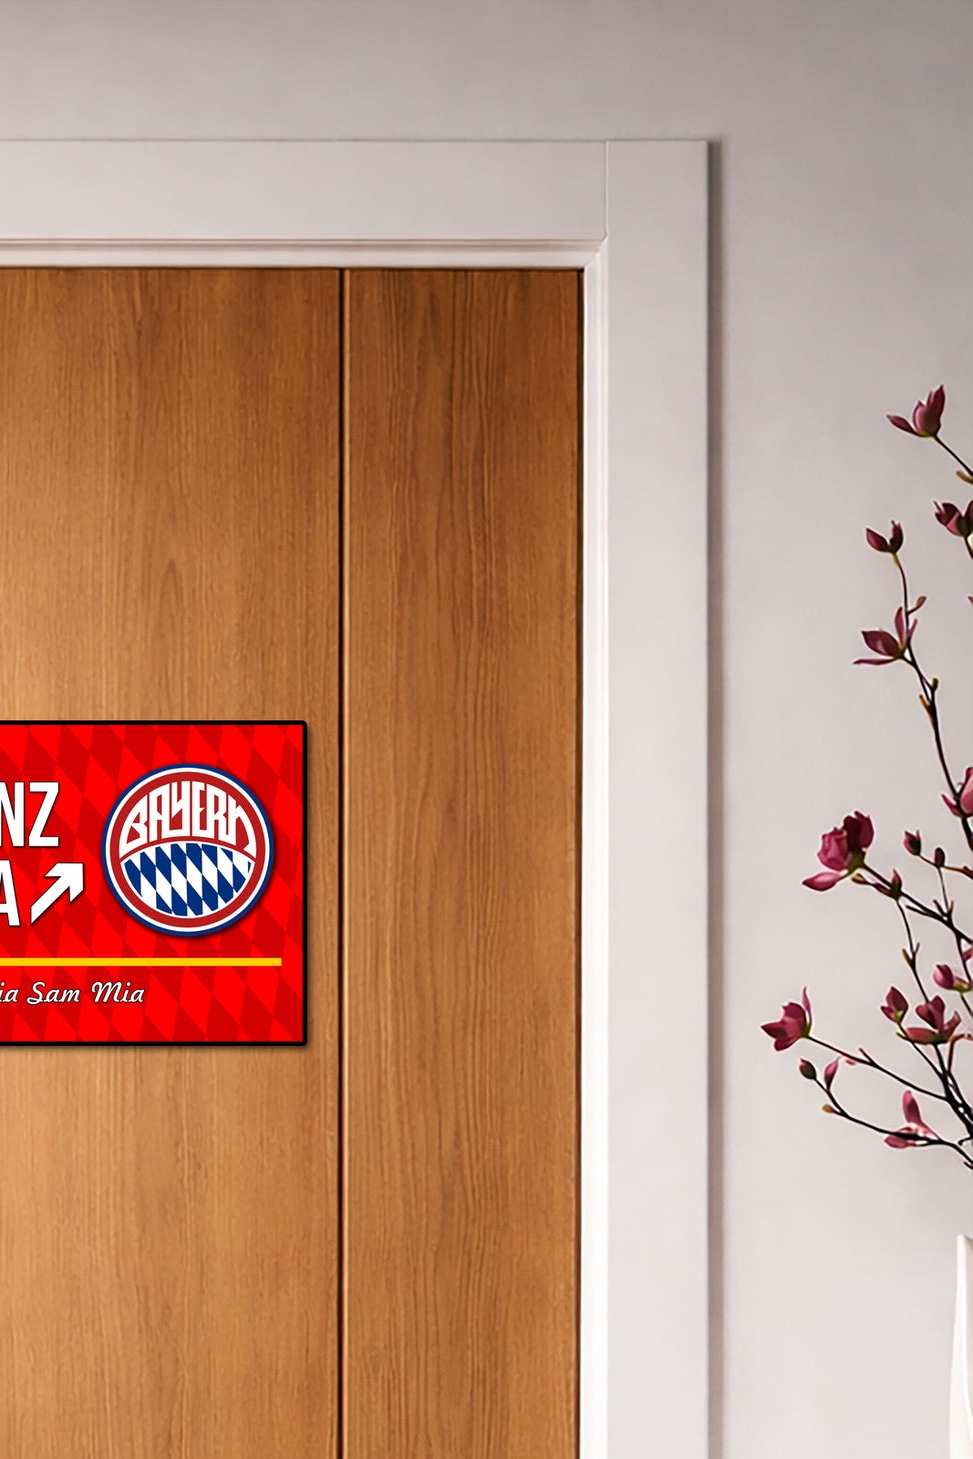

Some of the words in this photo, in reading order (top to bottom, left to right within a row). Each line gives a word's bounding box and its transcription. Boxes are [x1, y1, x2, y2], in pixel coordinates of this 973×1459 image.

[118, 780, 257, 859] BAYERN
[27, 981, 80, 1005] Sam
[91, 981, 145, 1004] Mia
